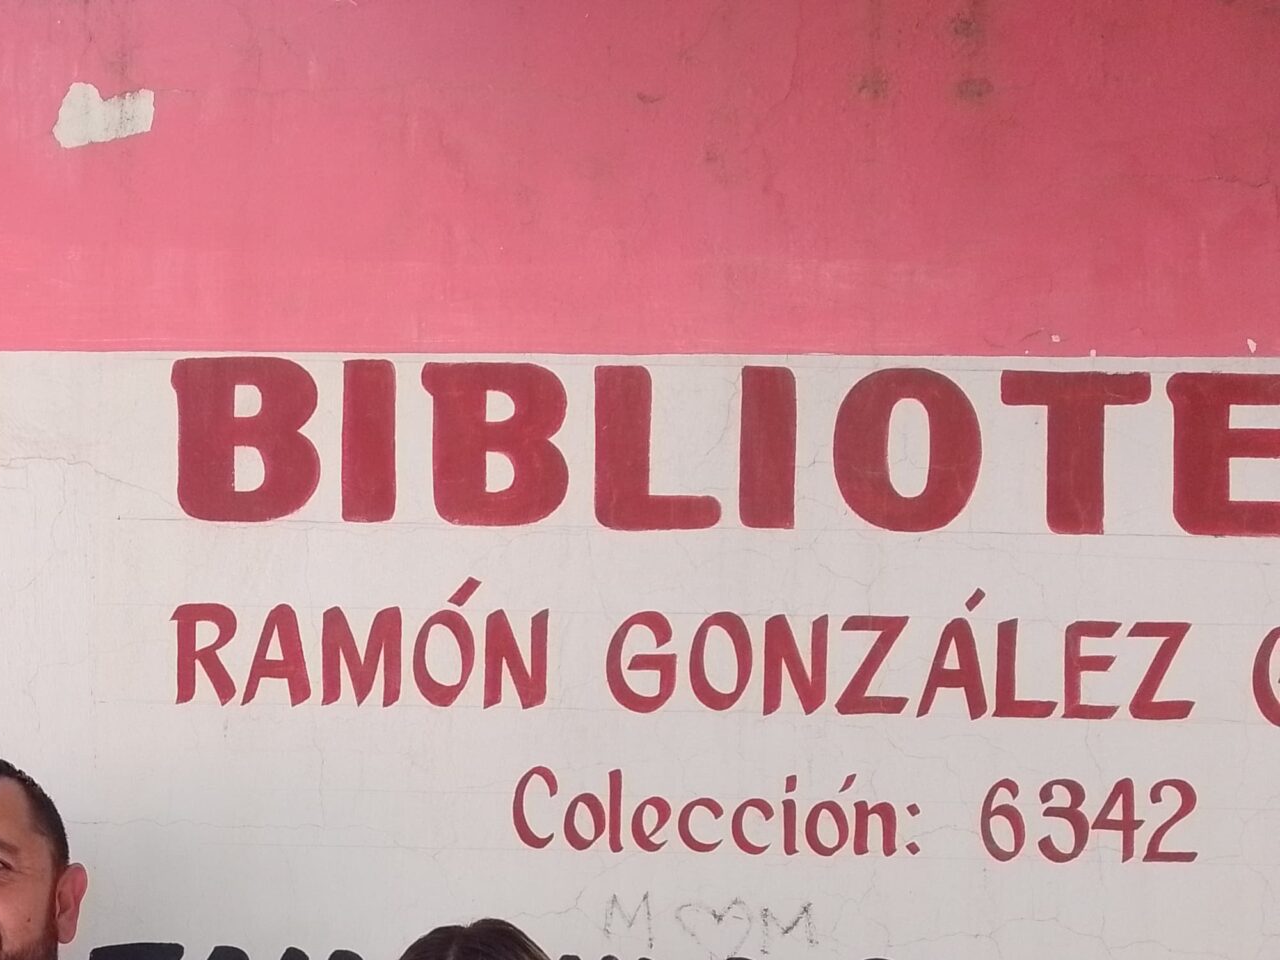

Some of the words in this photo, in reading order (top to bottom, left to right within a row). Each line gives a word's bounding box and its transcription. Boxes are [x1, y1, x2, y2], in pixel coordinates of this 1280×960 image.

[171, 357, 1280, 537] BIBLIOTE
[170, 576, 550, 710] RAMÓN
[606, 587, 1196, 721] GONZÁLEZ
[512, 765, 922, 857] Colección:
[979, 777, 1198, 863] 6342
